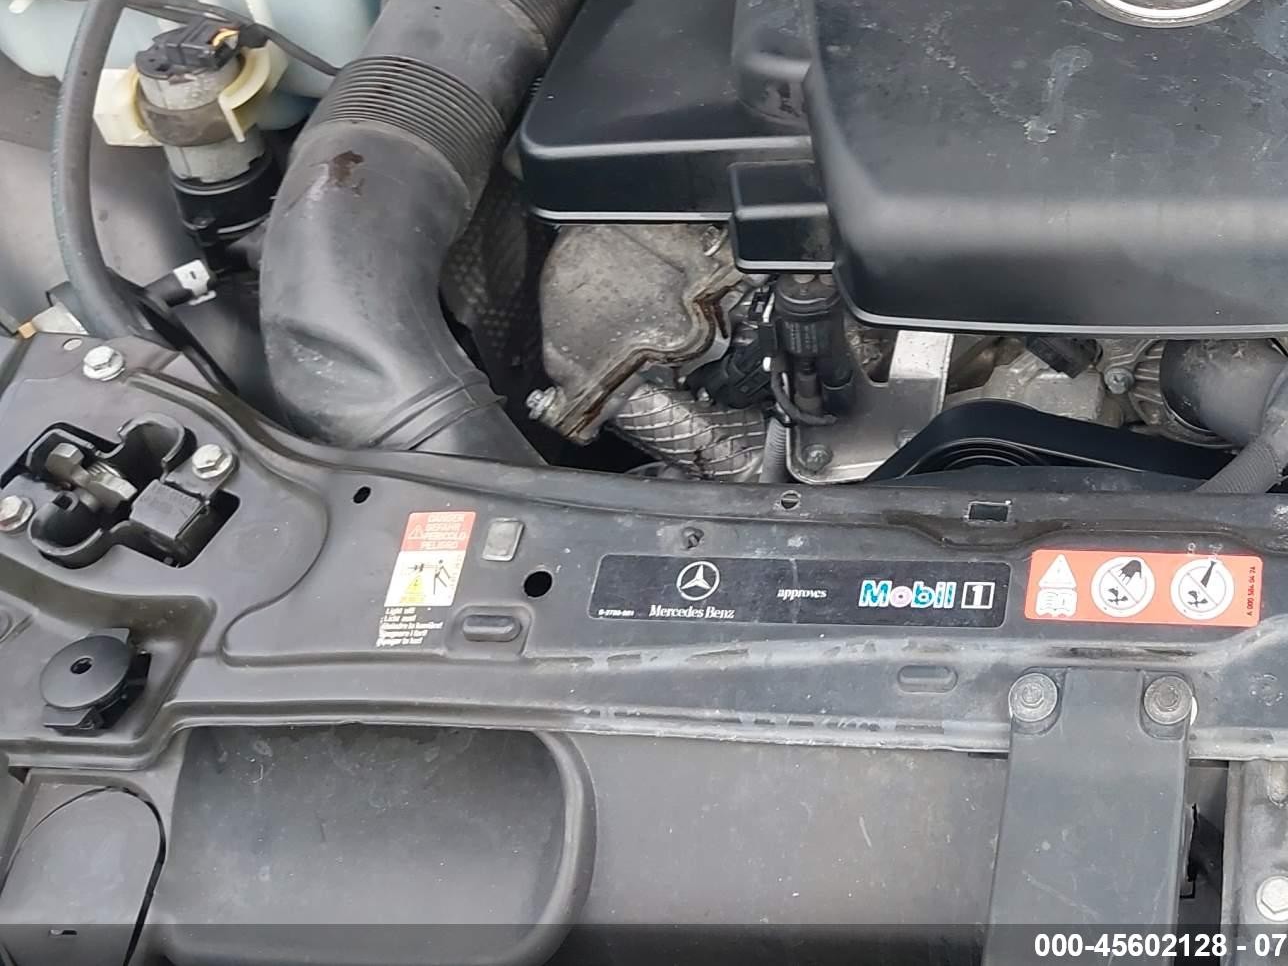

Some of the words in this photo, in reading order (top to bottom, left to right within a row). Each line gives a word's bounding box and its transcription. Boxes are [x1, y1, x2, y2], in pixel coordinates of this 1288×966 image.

[777, 588, 827, 601] approves
[858, 579, 957, 609] Mobil
[705, 605, 735, 619] Benz
